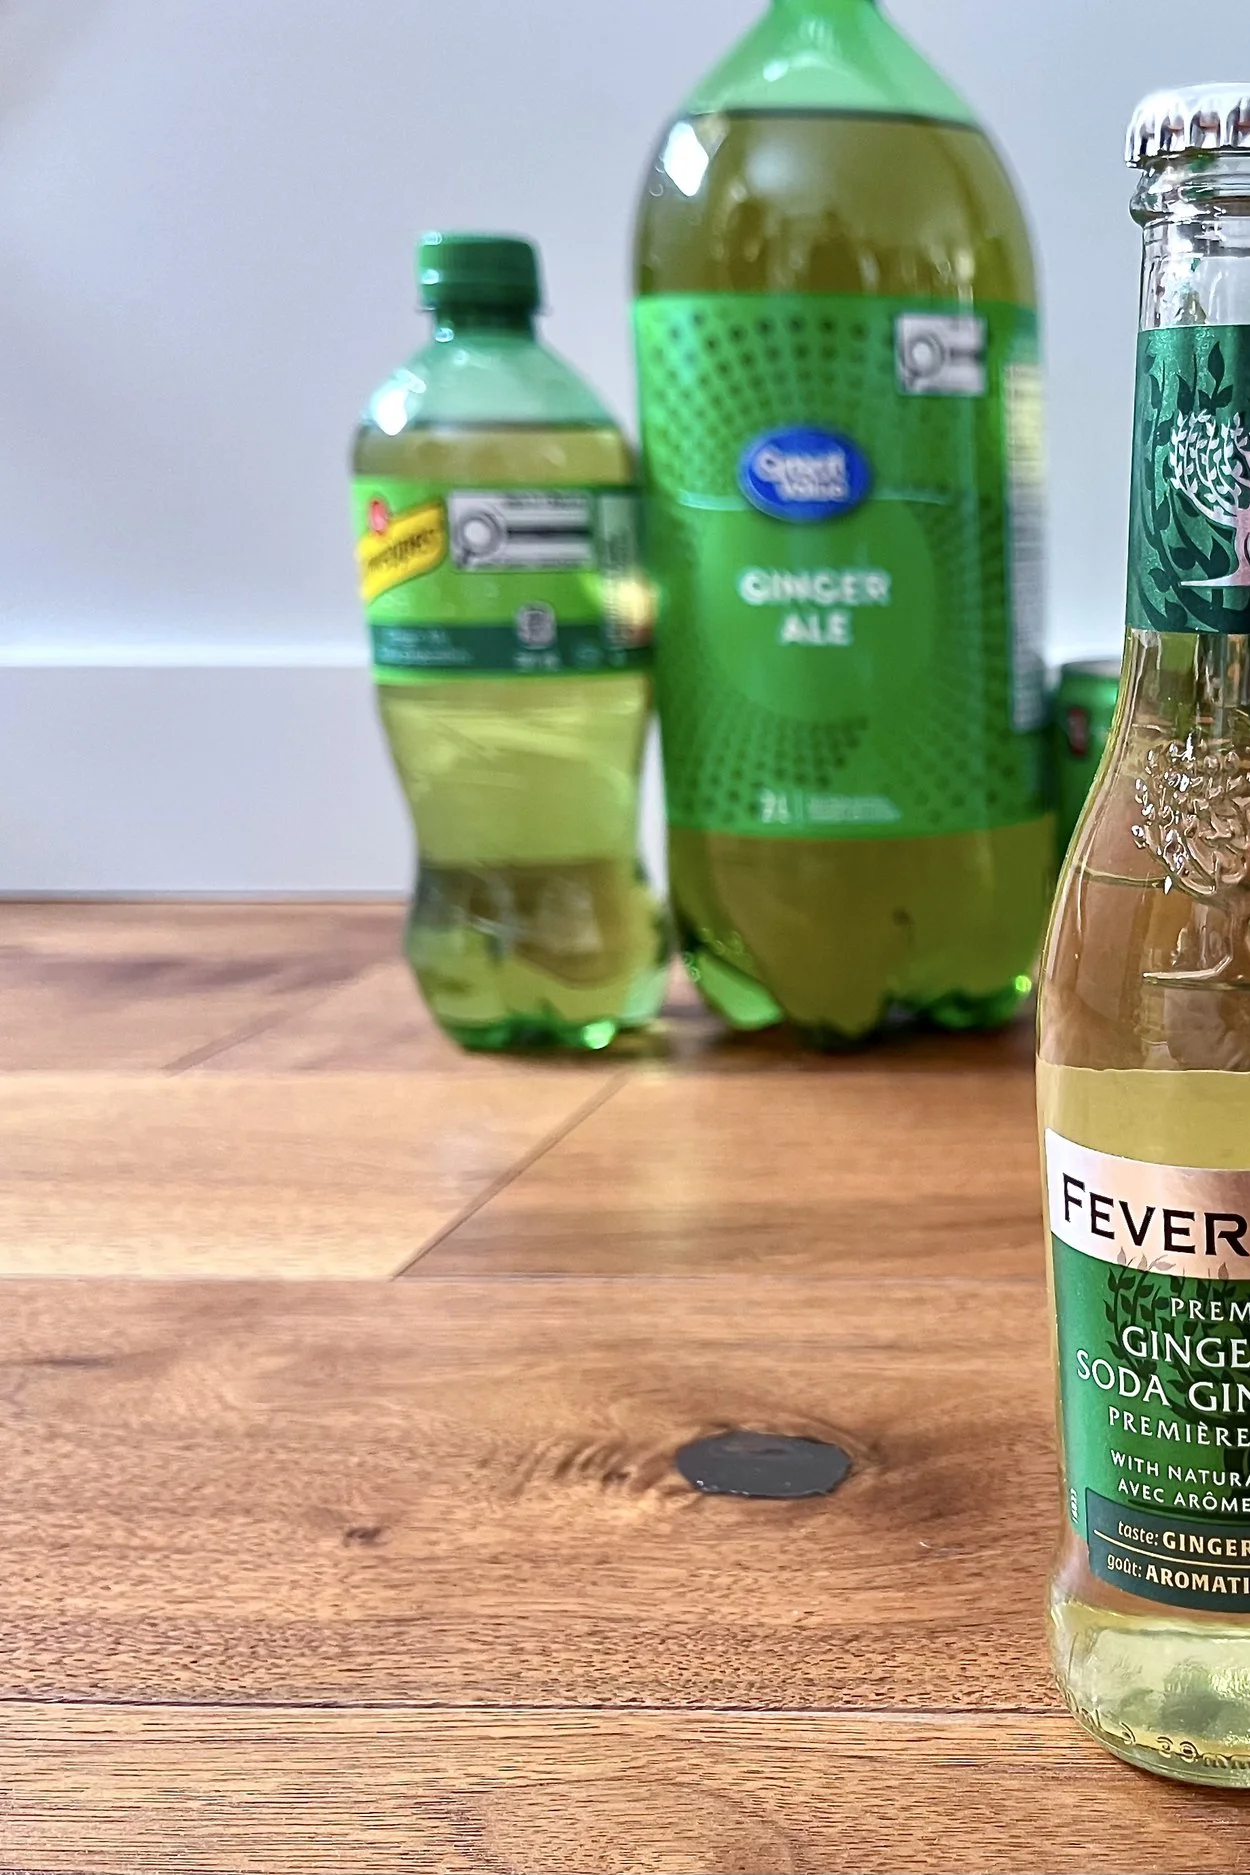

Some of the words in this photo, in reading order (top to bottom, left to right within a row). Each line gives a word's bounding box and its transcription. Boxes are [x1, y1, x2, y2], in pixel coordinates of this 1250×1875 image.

[738, 568, 892, 606] GINGER
[780, 612, 853, 646] ALE
[1076, 1348, 1172, 1408] SODA
[1107, 1405, 1250, 1448] PREMIÈRE
[1110, 1449, 1160, 1477] WITH
[1117, 1477, 1165, 1504] AVEC
[1117, 1520, 1159, 1547] taste:
[1106, 1551, 1143, 1579] goût:
